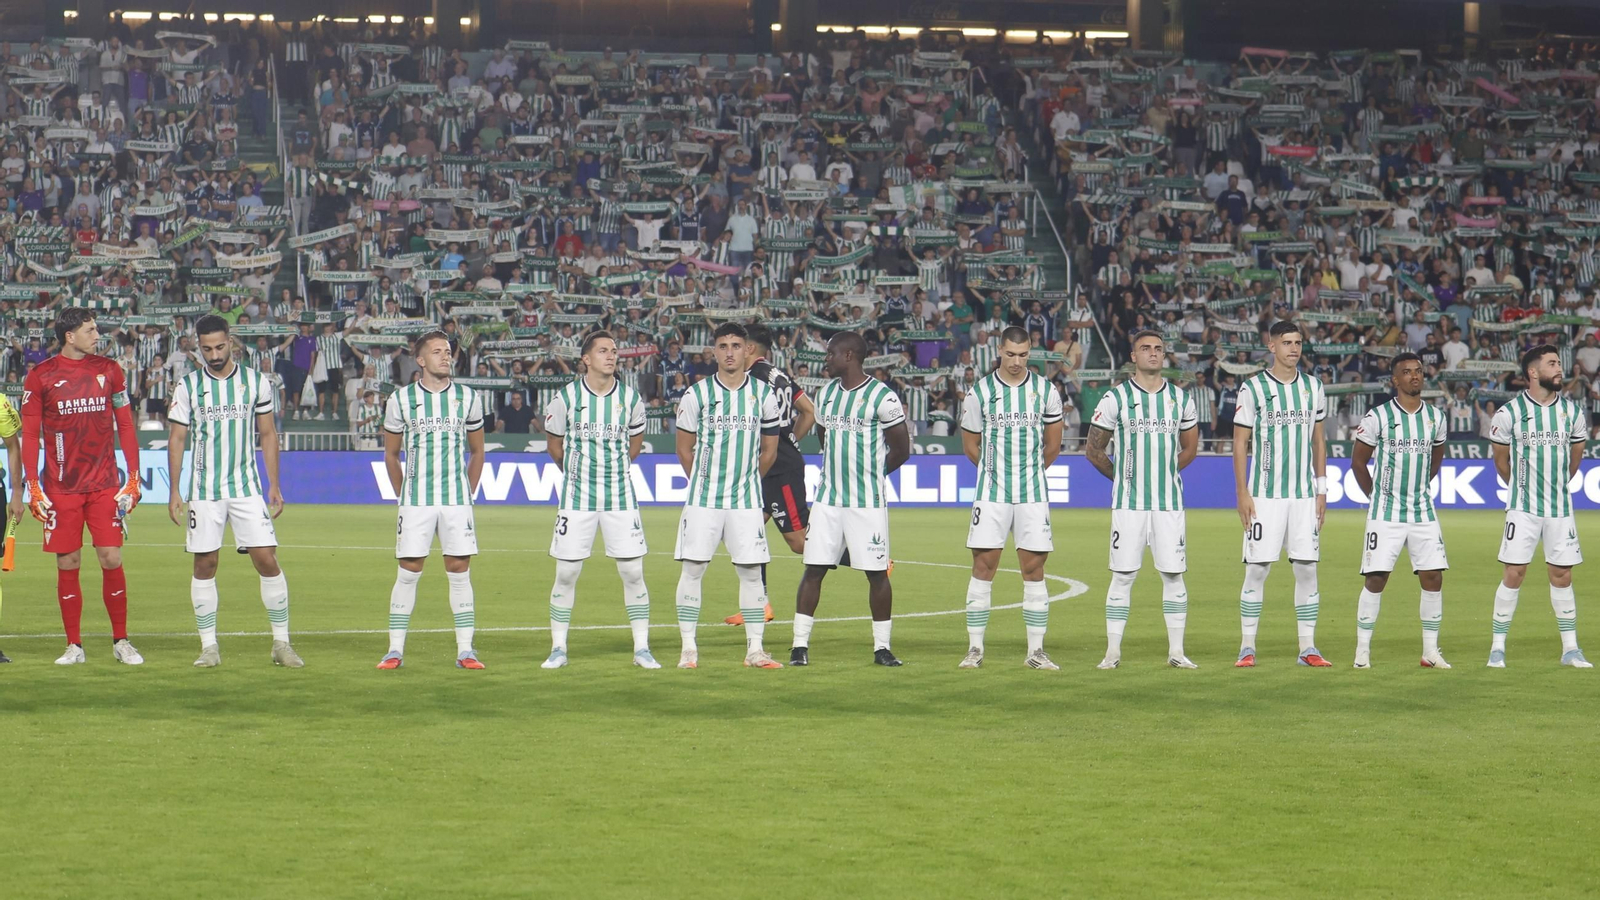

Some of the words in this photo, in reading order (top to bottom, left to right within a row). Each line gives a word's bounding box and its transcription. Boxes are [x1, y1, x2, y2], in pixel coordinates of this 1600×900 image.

[58, 397, 106, 410] BAHRAIN
[59, 405, 106, 415] VICTORIOUS
[200, 404, 248, 415] BAHRAIN
[709, 415, 758, 424] BAHRAIN
[990, 412, 1039, 422] BAHRAIN
[412, 417, 463, 428] BAHRAIN
[1130, 418, 1178, 427] BAHRAIN
[1522, 431, 1570, 440] BAHRAIN
[1366, 531, 1378, 551] 19
